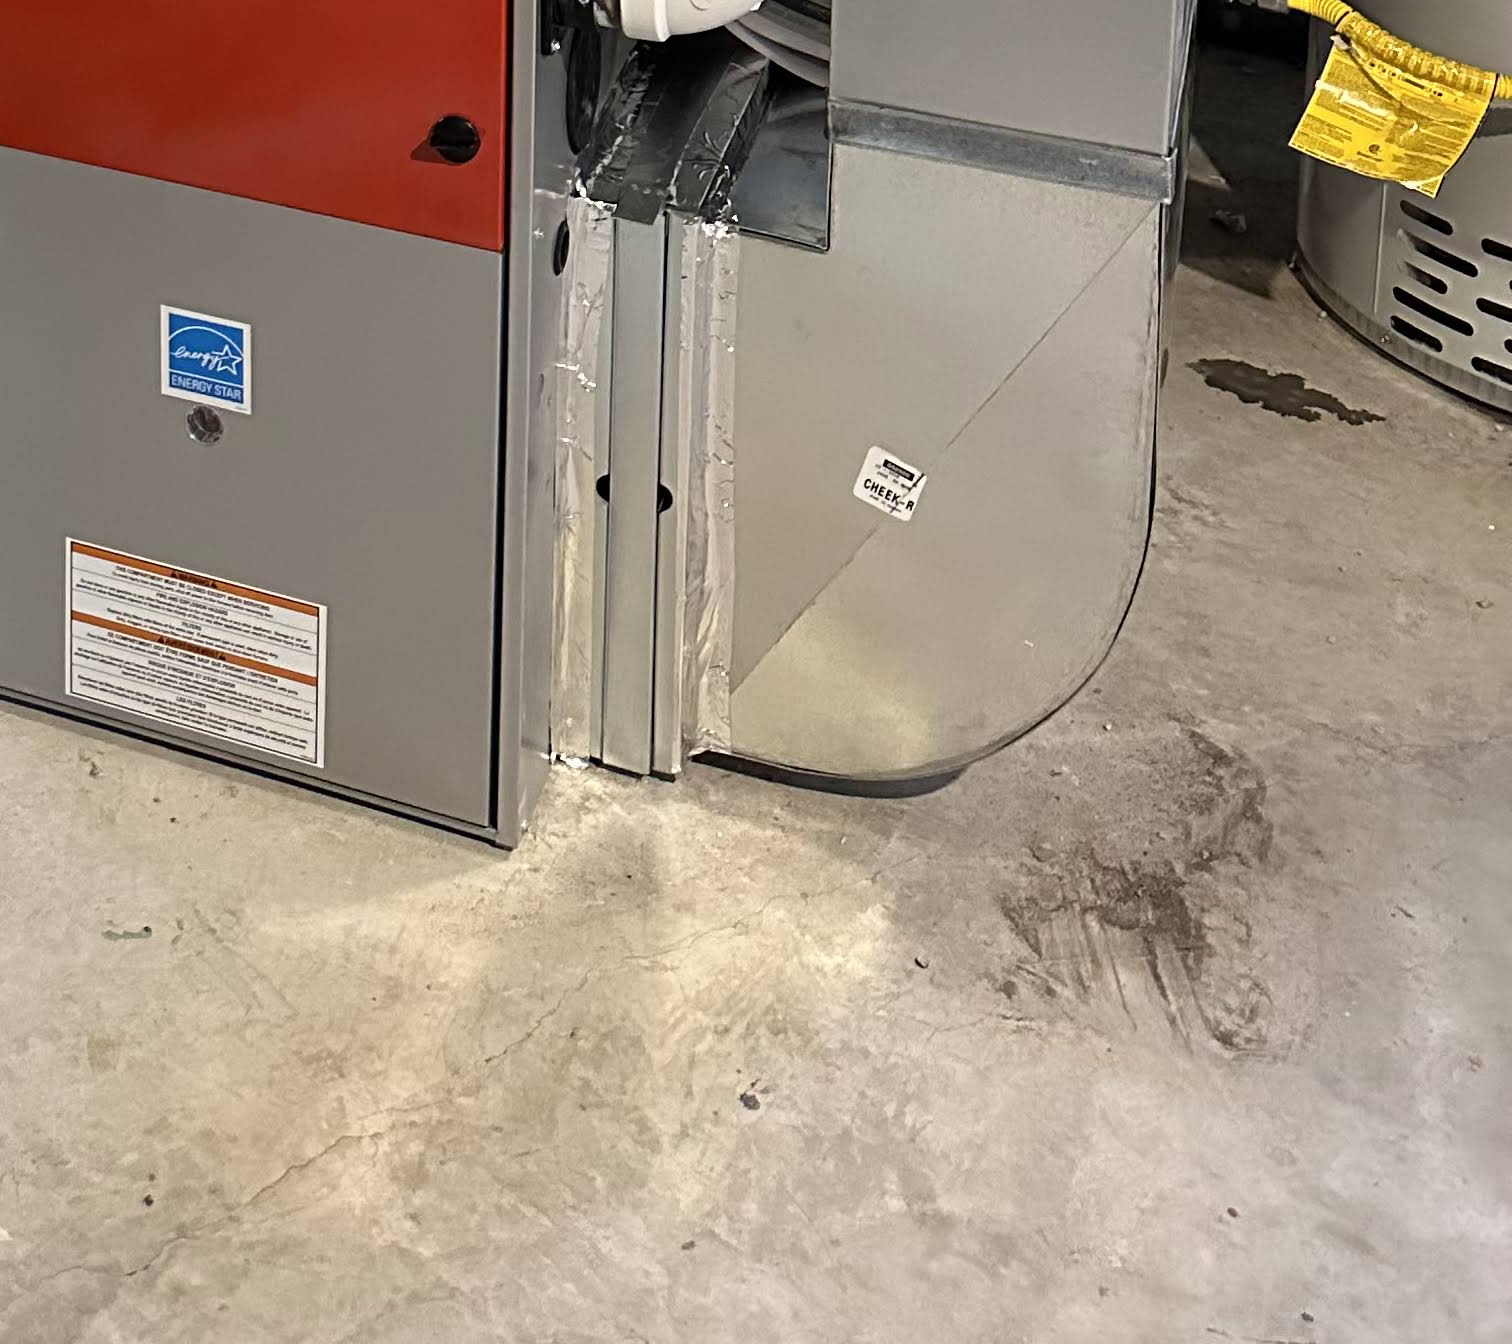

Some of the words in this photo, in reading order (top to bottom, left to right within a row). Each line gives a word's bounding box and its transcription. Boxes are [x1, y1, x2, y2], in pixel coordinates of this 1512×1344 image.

[172, 374, 212, 392] ENERGY
[214, 384, 242, 400] STAR
[864, 479, 914, 511] CHEEK-R
